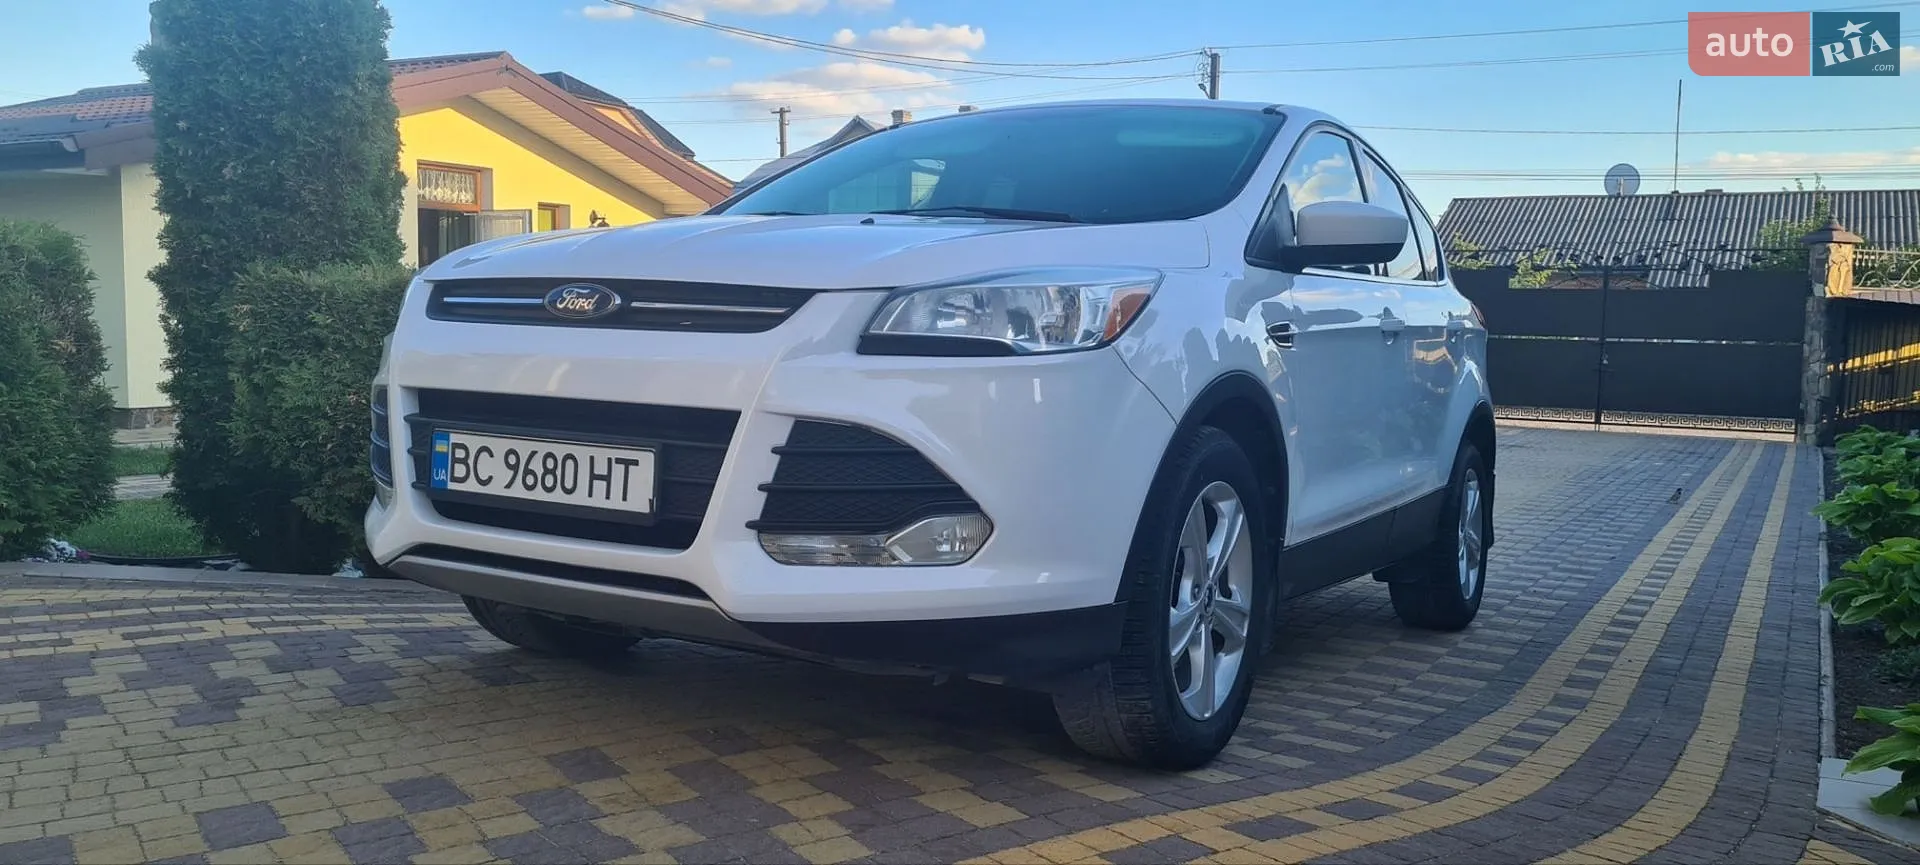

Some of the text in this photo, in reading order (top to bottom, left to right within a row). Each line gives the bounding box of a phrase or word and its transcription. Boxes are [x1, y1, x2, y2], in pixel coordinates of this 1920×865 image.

[556, 287, 600, 310] Ford
[433, 469, 447, 481] UA
[450, 442, 639, 502] BC 9680 HT
